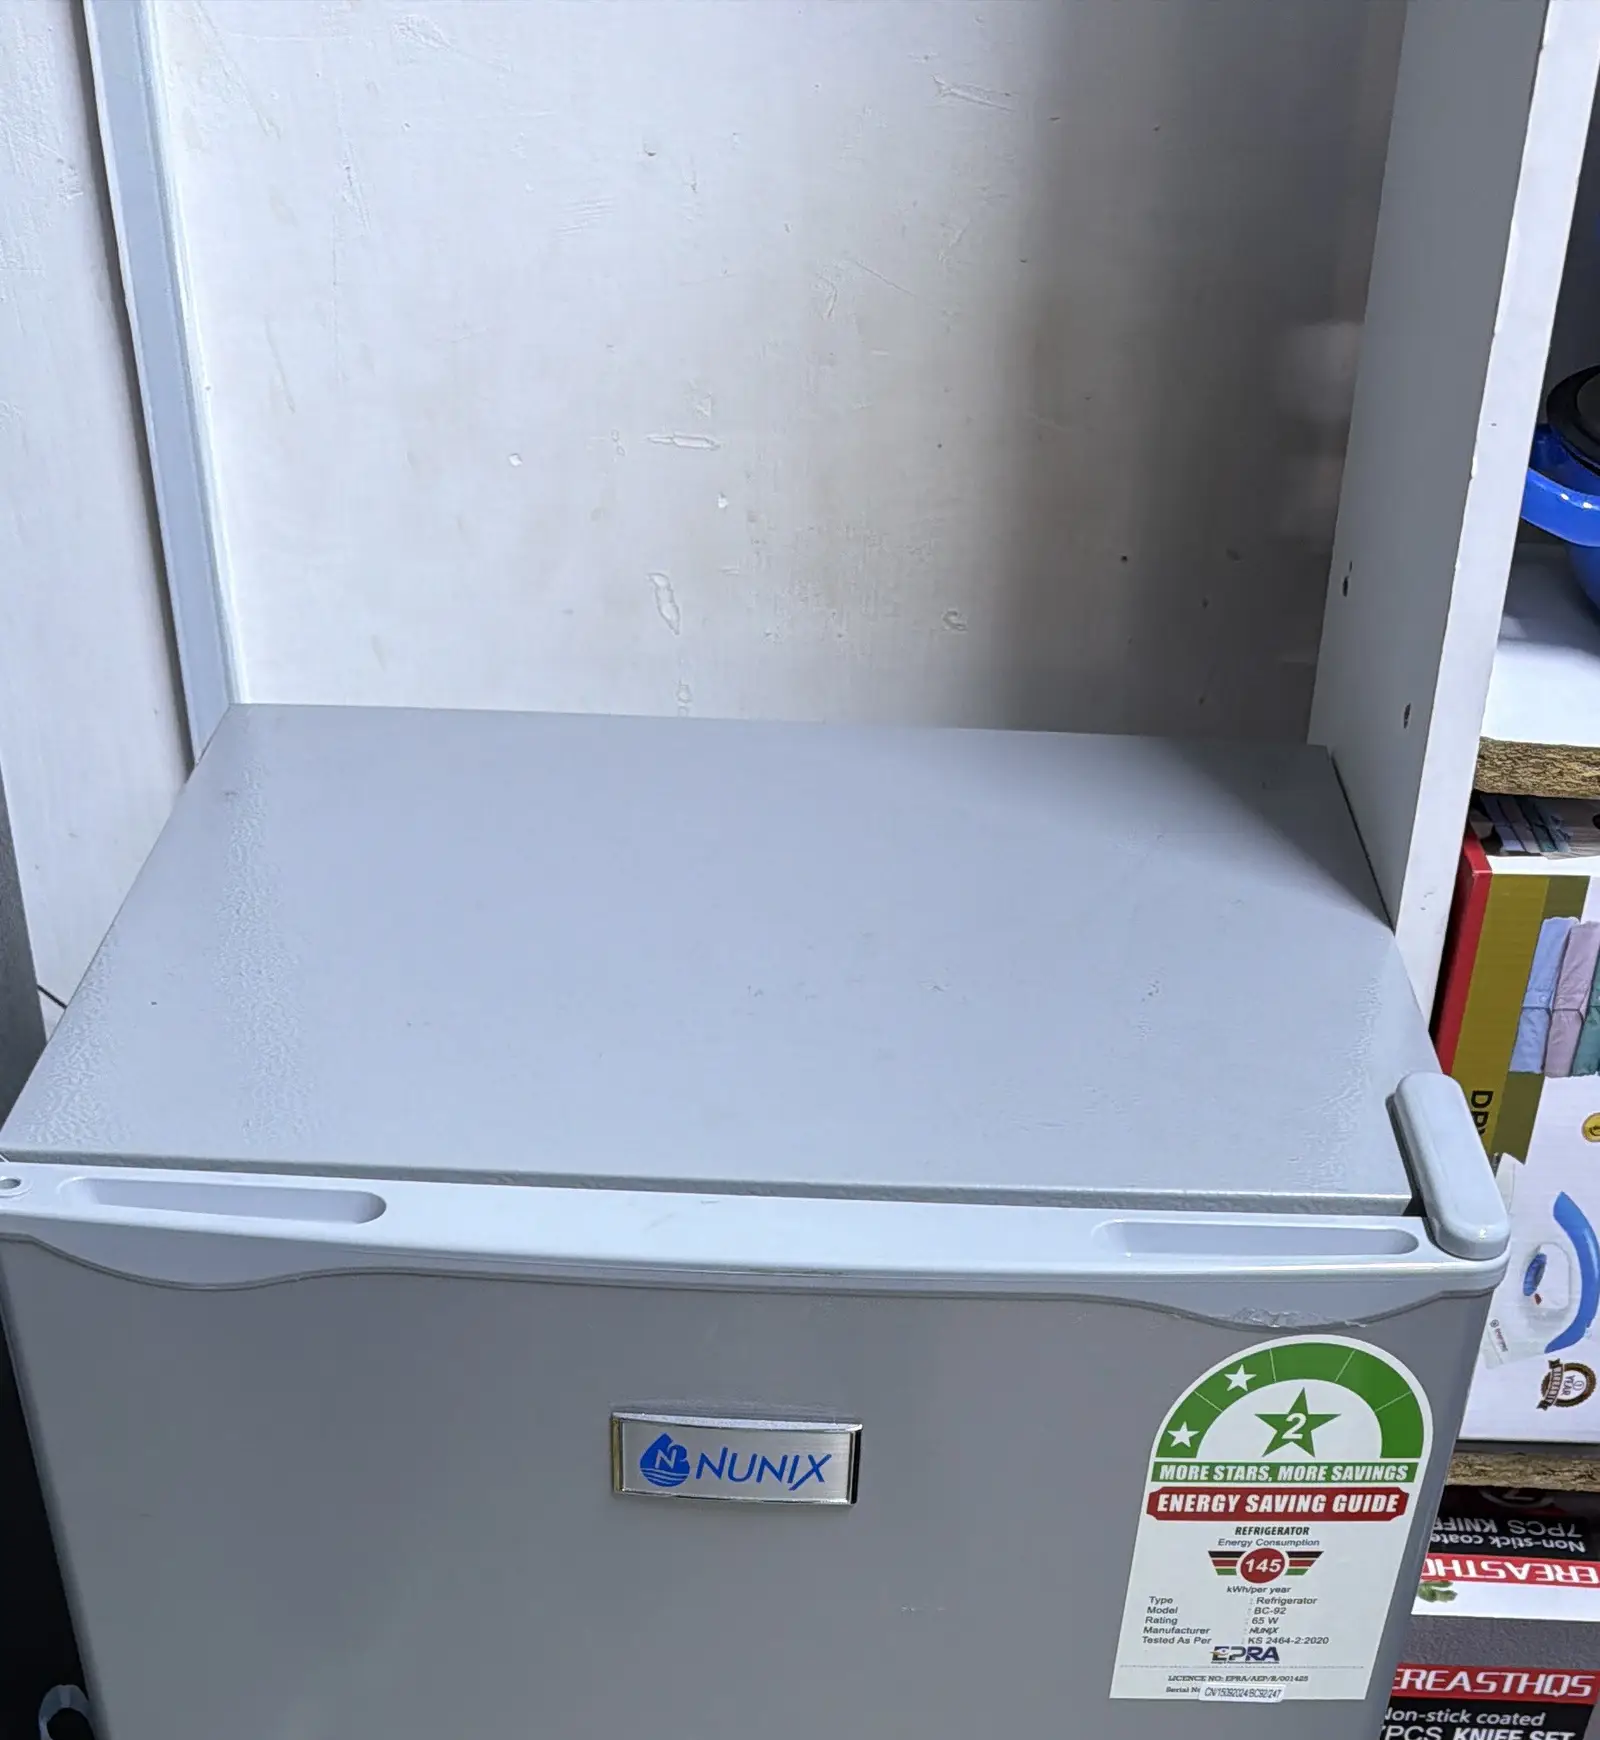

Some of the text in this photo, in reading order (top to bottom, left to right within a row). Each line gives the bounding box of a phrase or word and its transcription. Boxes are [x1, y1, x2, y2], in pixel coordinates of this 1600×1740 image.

[1282, 1413, 1307, 1440] 2
[696, 1447, 832, 1491] NUNIX
[1159, 1465, 1408, 1482] MORE STARS, MORE SAVINGS
[1157, 1494, 1400, 1513] ENERGY SAVING GUIDE
[1234, 1526, 1310, 1536] REFRIGERATOR
[1508, 1519, 1582, 1538] 7PCS
[1218, 1539, 1320, 1548] Energy Consumption
[1429, 1533, 1585, 1553] Non-stick coate
[1245, 1558, 1283, 1573] 145
[1269, 1587, 1291, 1596] year
[1149, 1596, 1318, 1605] Type Refrigerator
[1146, 1606, 1287, 1615] Model BC-92
[1145, 1616, 1279, 1625] Rating 65 W
[1143, 1626, 1211, 1635] Manufacturer
[1142, 1636, 1175, 1645] Tested
[1176, 1636, 1191, 1645] As
[1193, 1636, 1212, 1645] Per
[1248, 1637, 1263, 1645] KS
[1211, 1646, 1280, 1662] EPRA
[1476, 1712, 1546, 1727] coated
